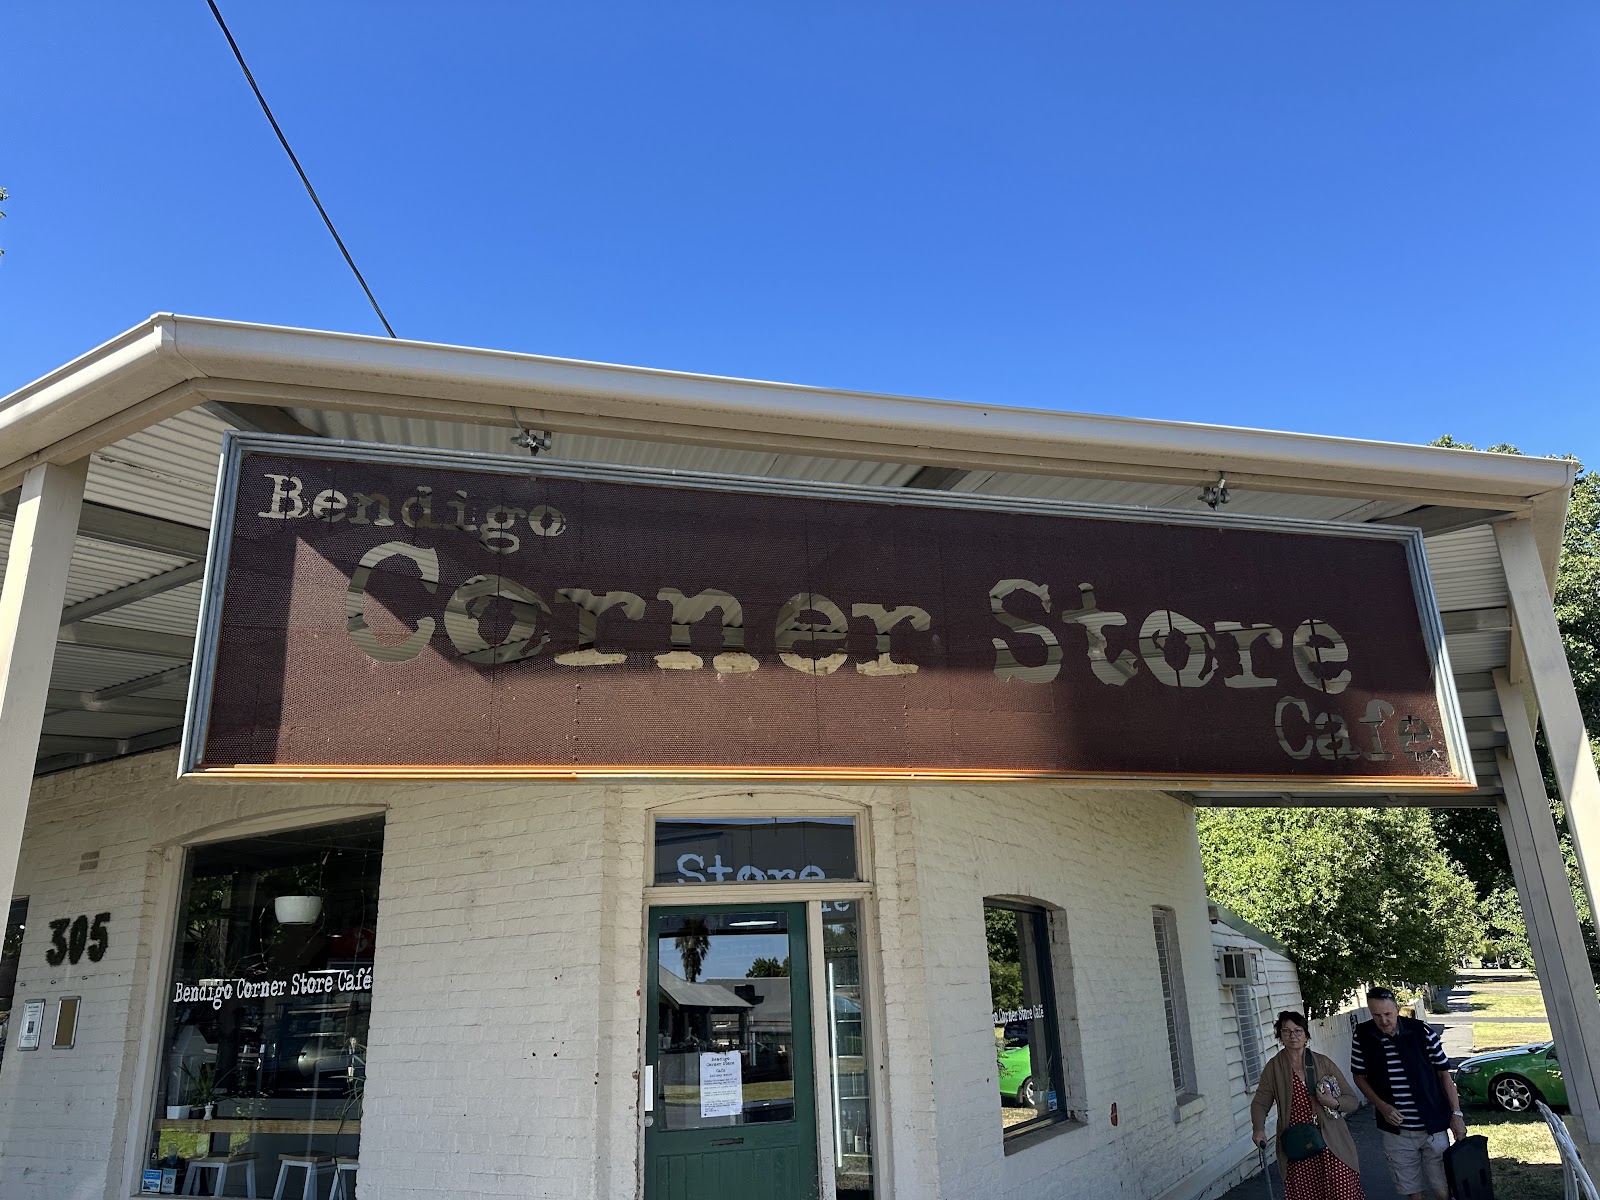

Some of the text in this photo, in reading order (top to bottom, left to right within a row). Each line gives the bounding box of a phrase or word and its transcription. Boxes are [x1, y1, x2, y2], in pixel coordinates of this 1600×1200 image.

[257, 473, 567, 555] Bendigo
[346, 540, 1351, 695] Corner Store
[46, 912, 111, 967] 305
[173, 967, 373, 1010] Bendigo Corner Store Café
